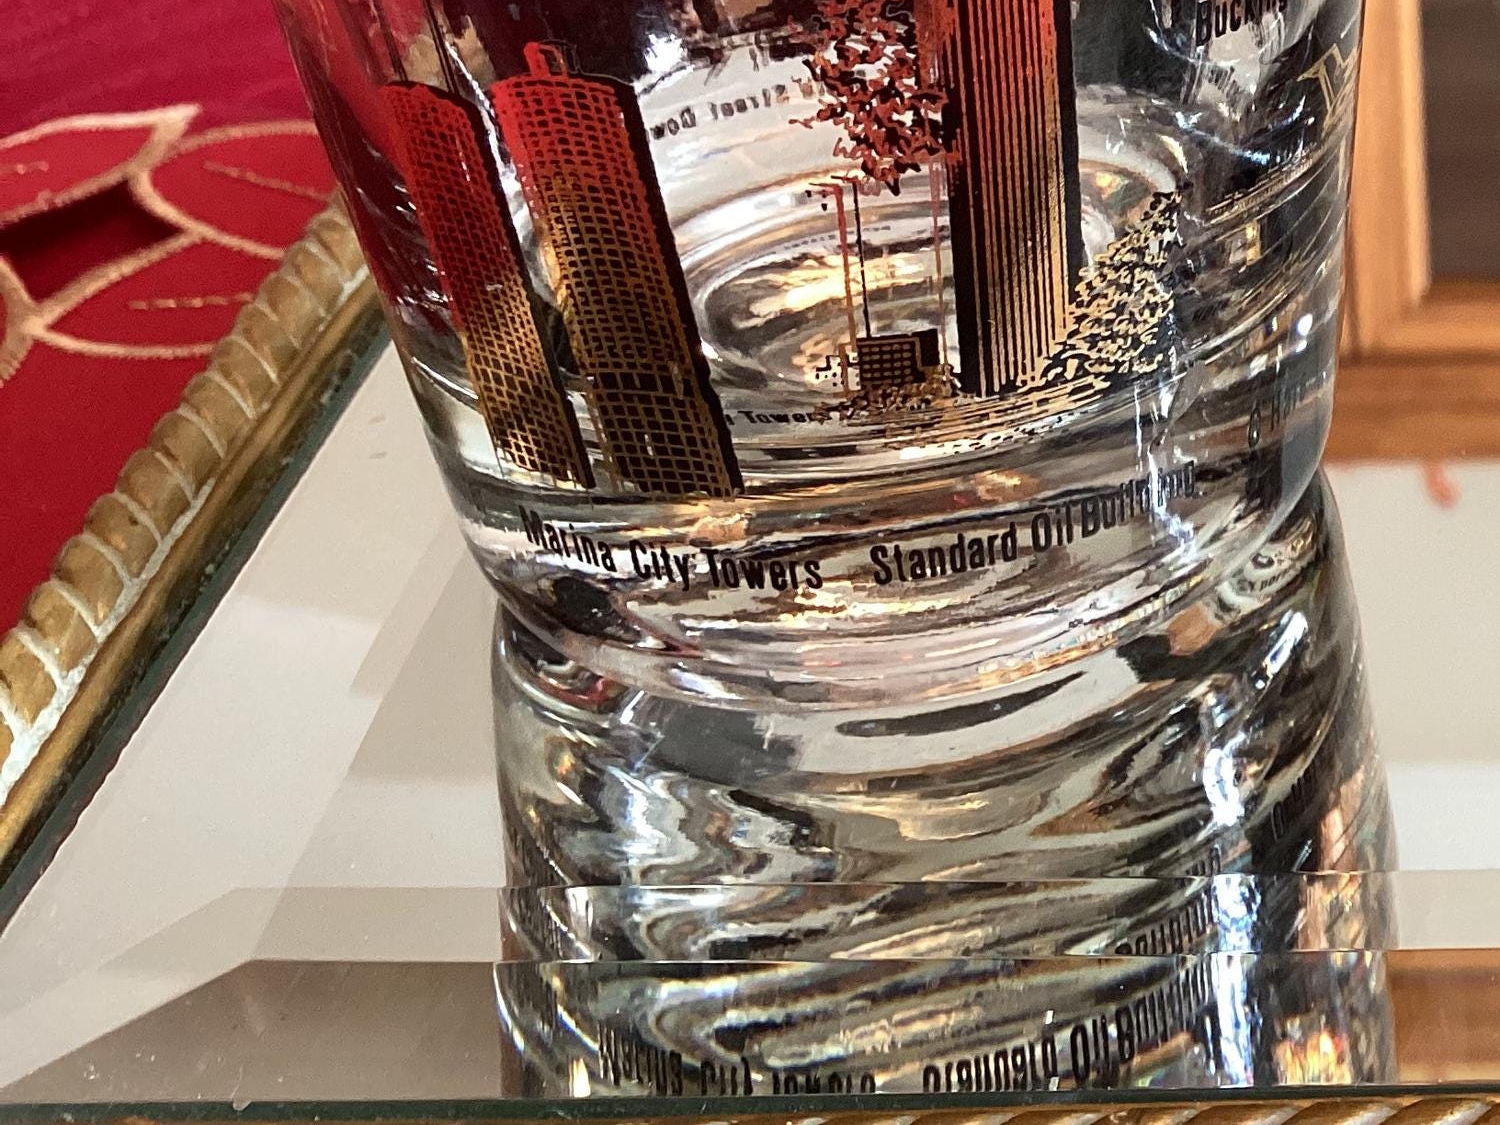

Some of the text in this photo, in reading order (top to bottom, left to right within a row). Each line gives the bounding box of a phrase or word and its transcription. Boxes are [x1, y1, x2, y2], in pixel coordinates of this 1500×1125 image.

[518, 505, 823, 591] Marina City Towers
[870, 521, 1018, 585] Standard
[1031, 501, 1073, 553] Oil
